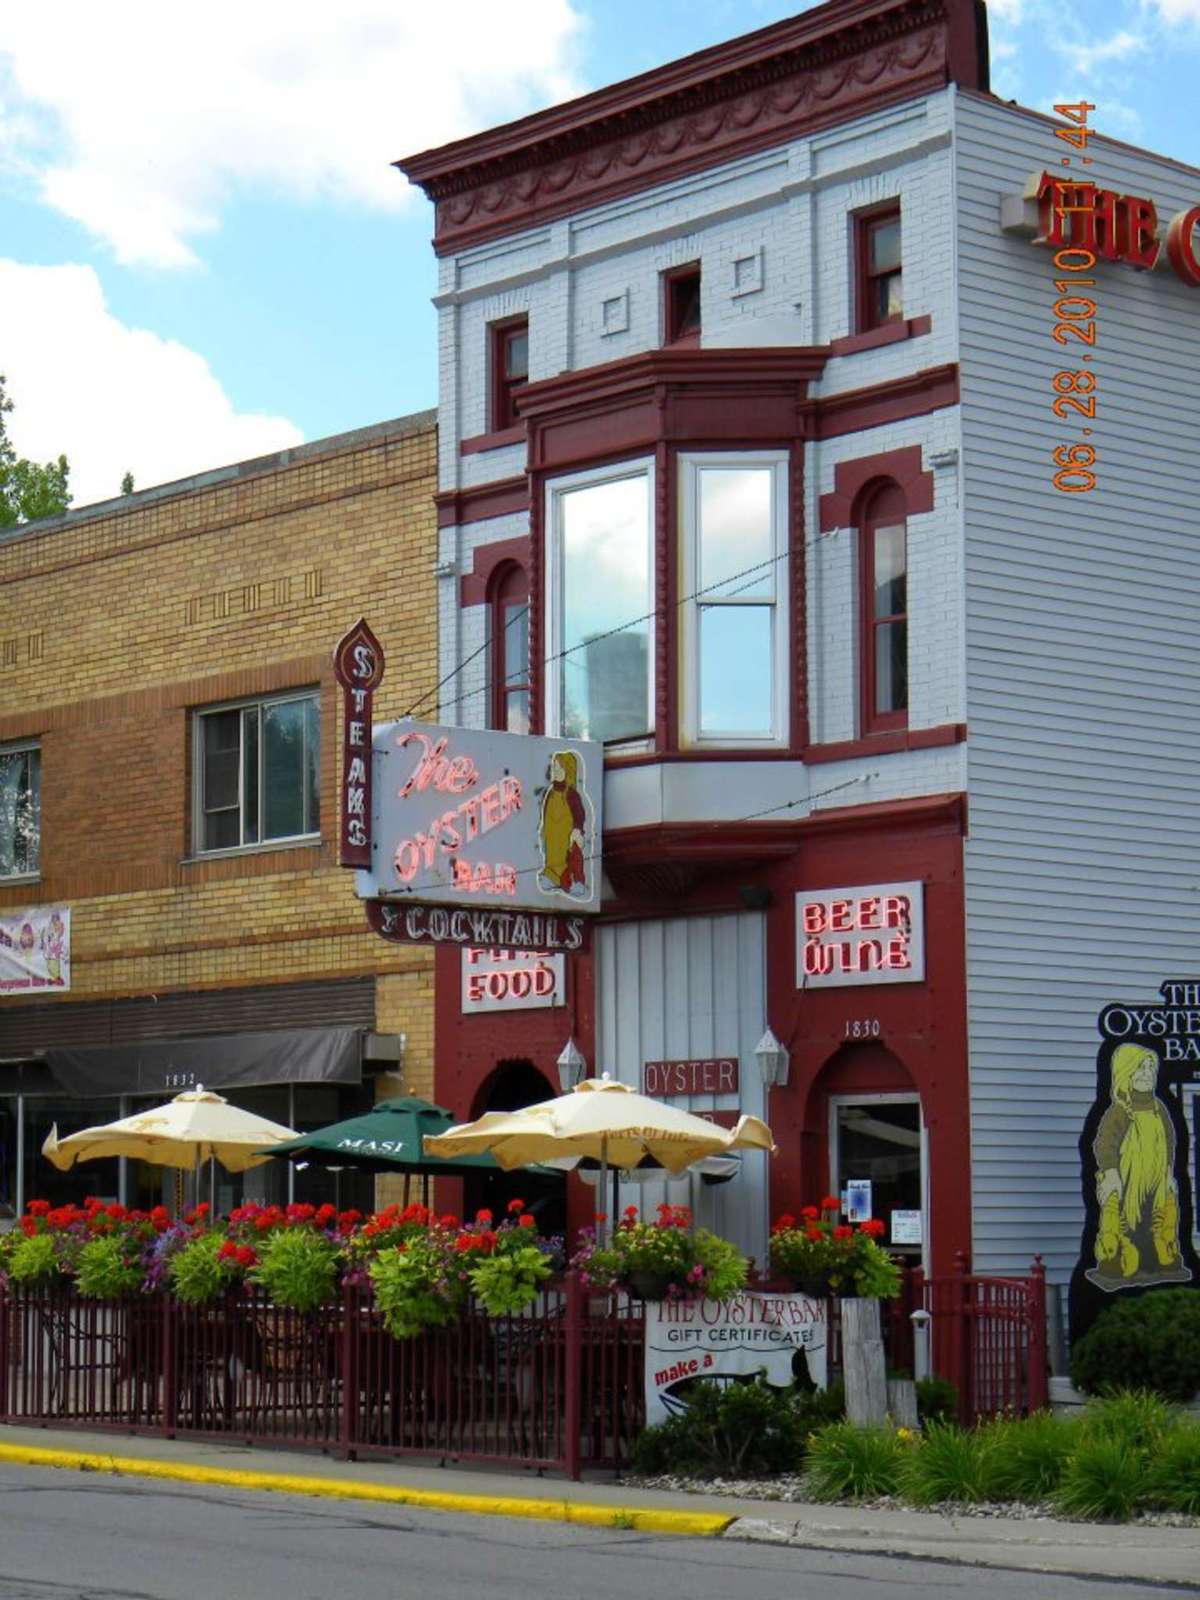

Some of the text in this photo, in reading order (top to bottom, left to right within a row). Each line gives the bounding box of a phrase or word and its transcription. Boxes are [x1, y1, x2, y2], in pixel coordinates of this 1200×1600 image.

[1031, 170, 1161, 271] THE
[347, 645, 374, 846] STEAKS
[396, 732, 479, 800] The
[394, 775, 523, 882] OYSTER
[452, 857, 518, 897] BAR
[405, 906, 585, 949] COCKTAILS
[803, 895, 910, 934] BEER
[803, 933, 911, 976] WINE
[467, 966, 557, 1001] FOOD
[646, 1061, 734, 1093] OYSTER
[337, 1138, 406, 1153] MASI
[657, 1299, 697, 1323] THE
[667, 1329, 703, 1342] GIFT
[654, 1353, 714, 1386] make a
